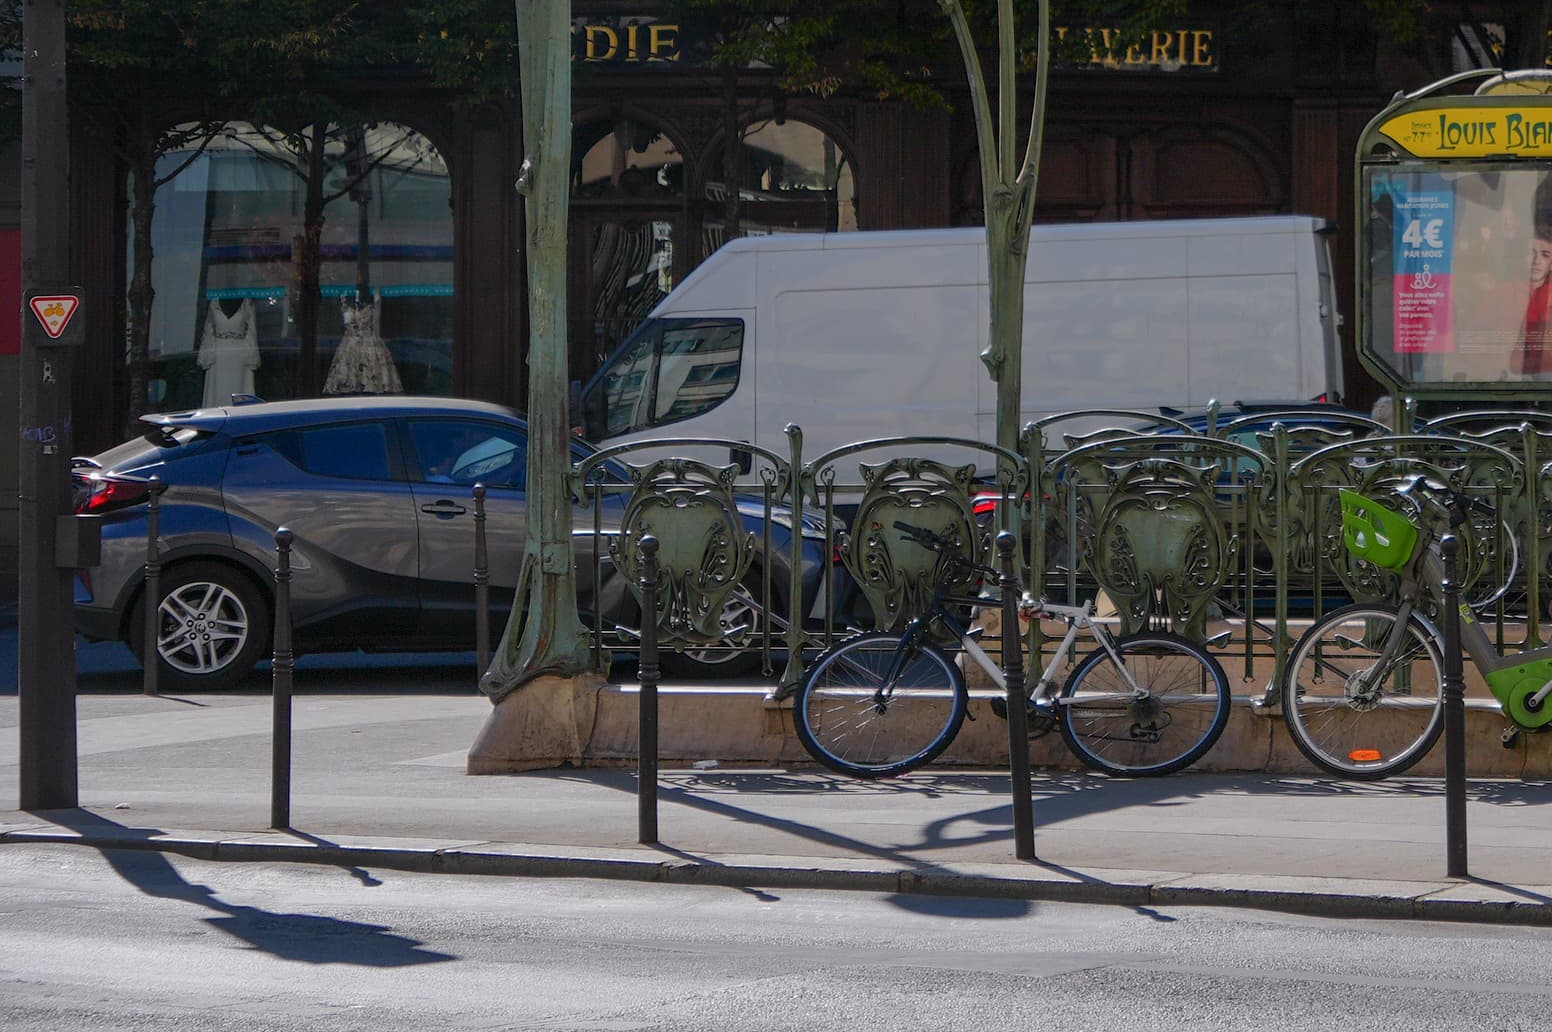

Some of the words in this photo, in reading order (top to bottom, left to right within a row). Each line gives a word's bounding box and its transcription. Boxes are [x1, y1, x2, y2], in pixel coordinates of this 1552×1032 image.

[1436, 113, 1497, 150] LOUIS
[1402, 218, 1444, 249] 4€
[1403, 250, 1420, 259] PAR
